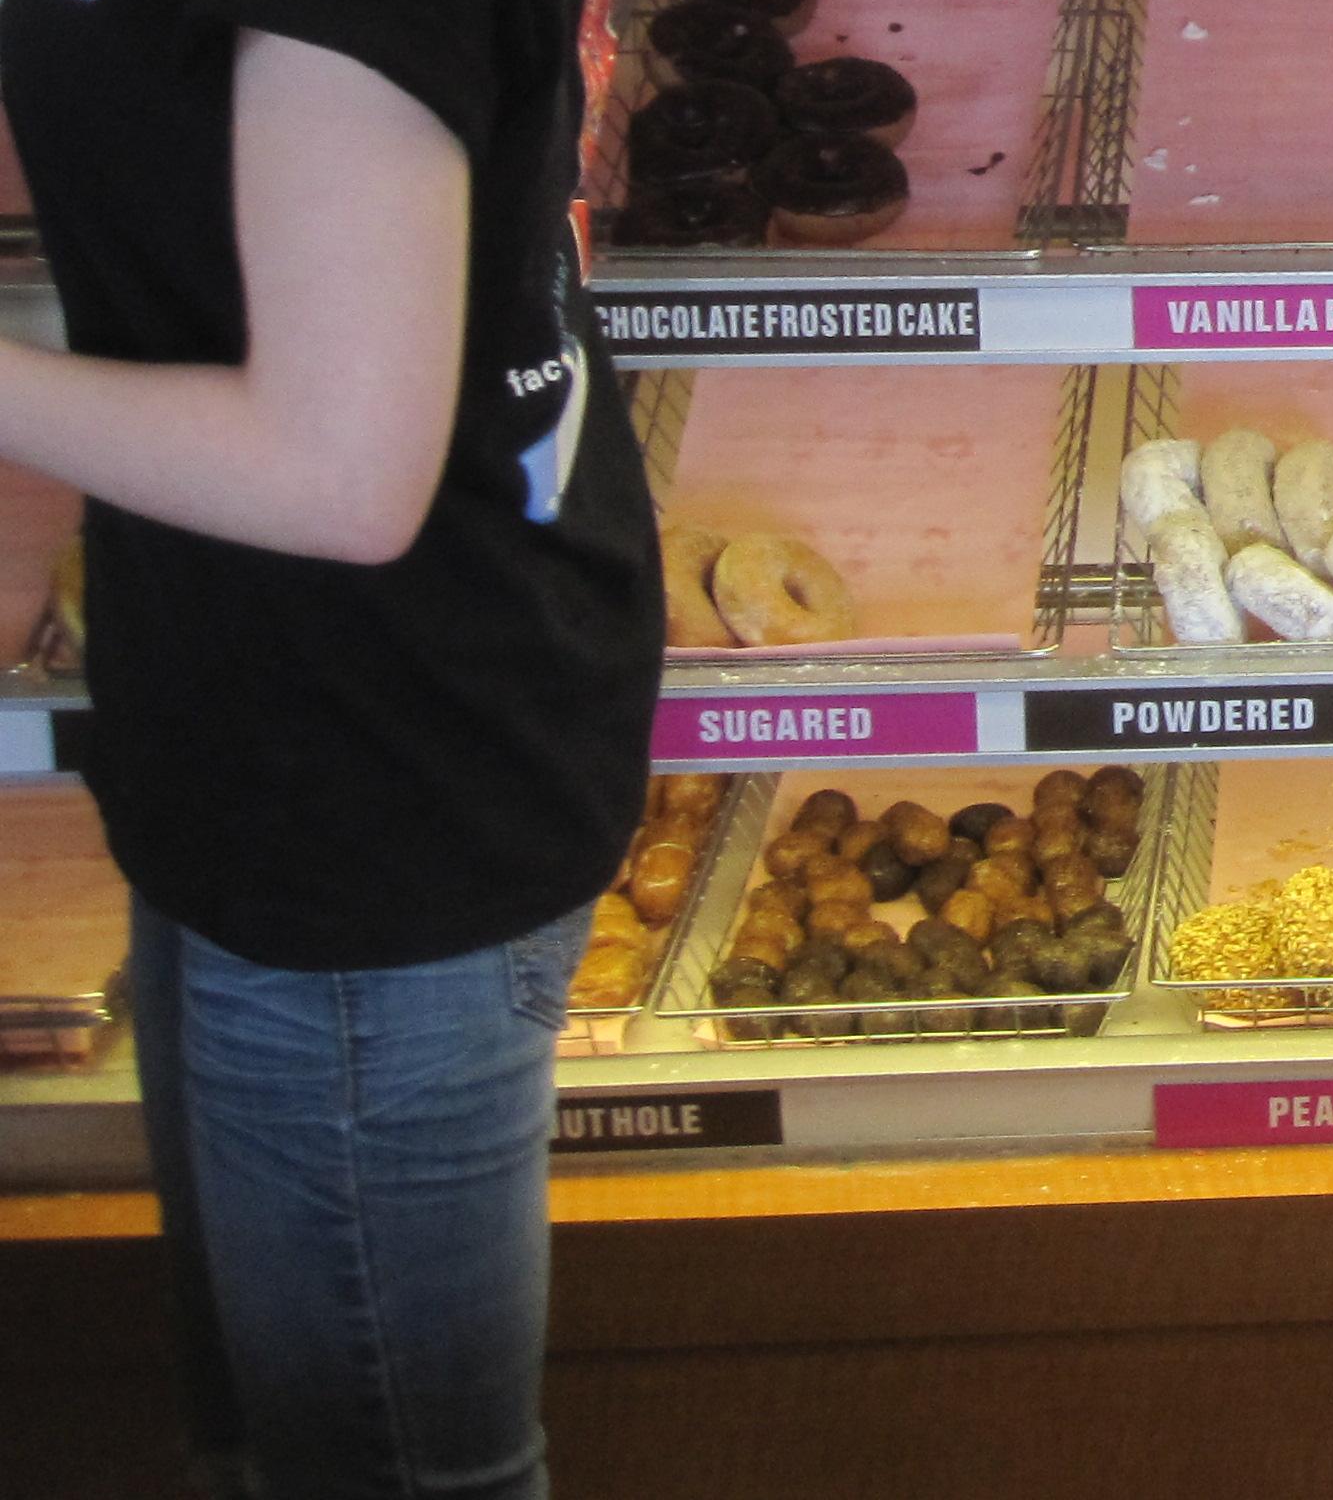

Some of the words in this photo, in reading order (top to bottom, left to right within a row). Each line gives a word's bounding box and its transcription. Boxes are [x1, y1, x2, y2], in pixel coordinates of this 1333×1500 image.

[763, 303, 893, 338] FROSTED
[897, 302, 975, 337] CAKE
[1167, 298, 1319, 334] VANILLA
[699, 707, 873, 743] SUGARED
[1113, 697, 1315, 734] POWDERED
[552, 1107, 606, 1140] UT
[610, 1103, 703, 1137] HOLE
